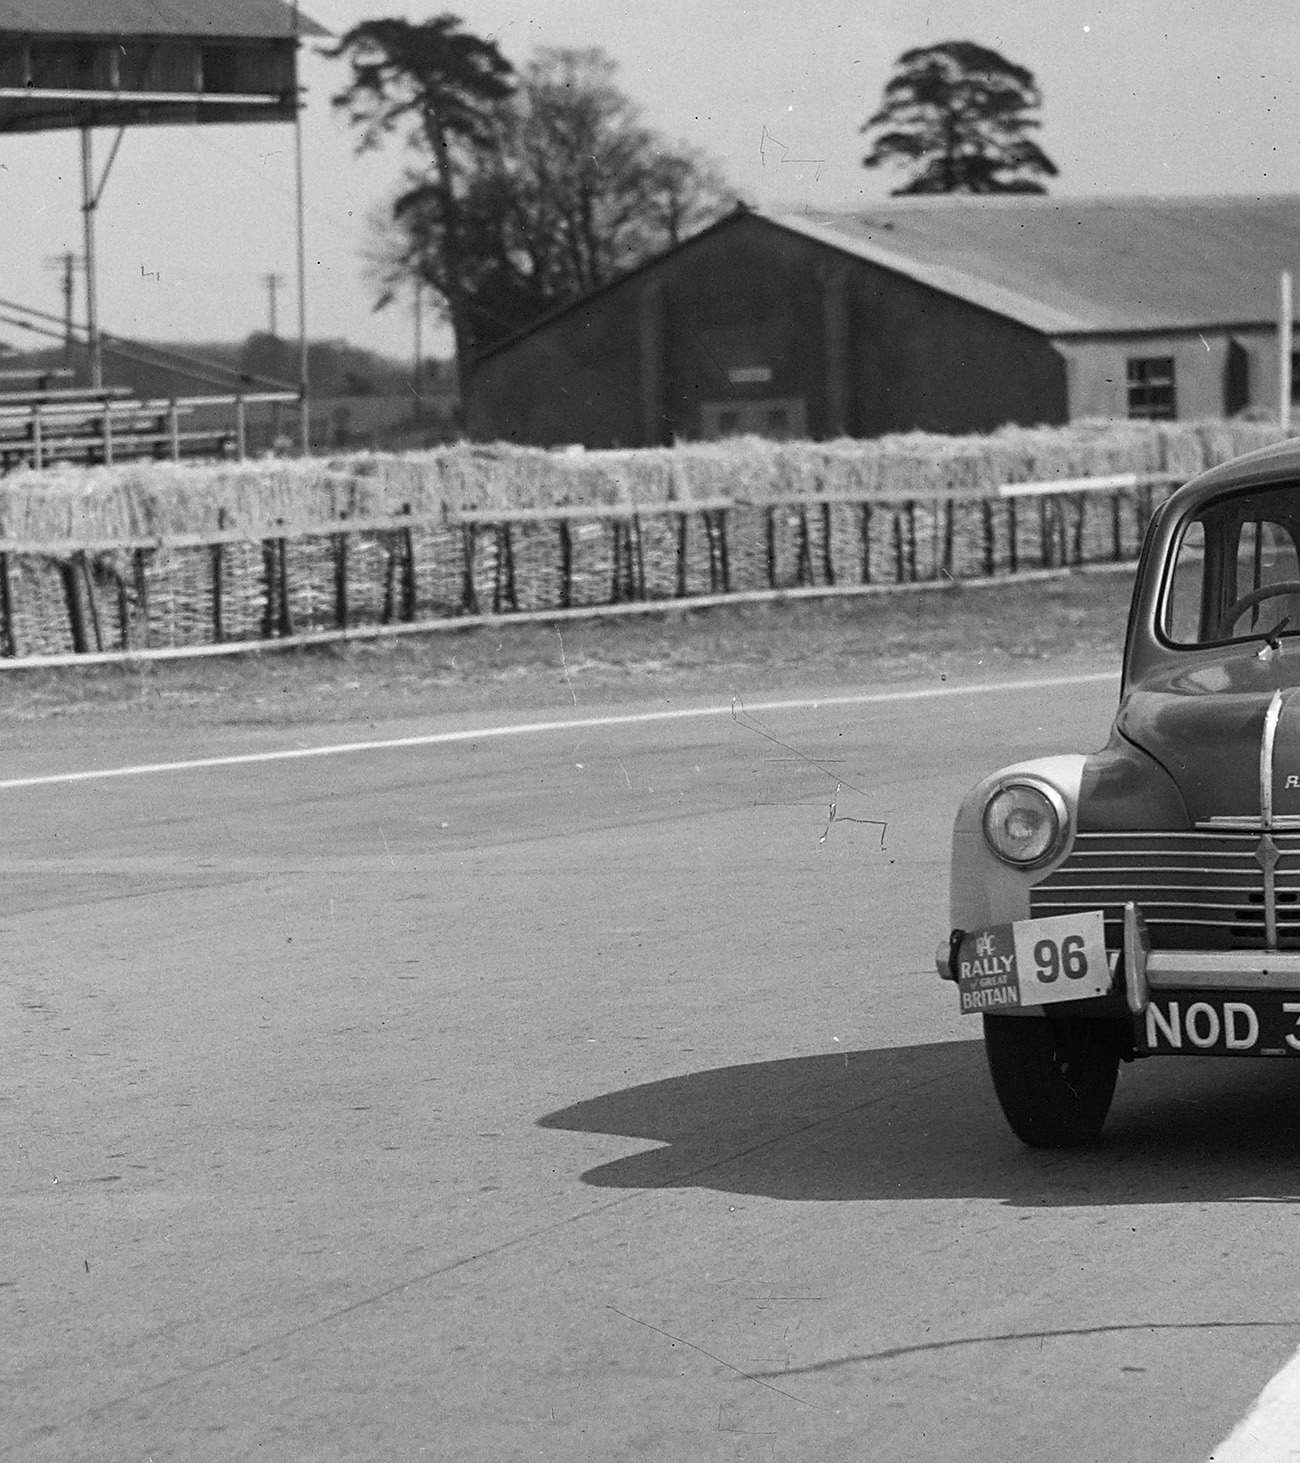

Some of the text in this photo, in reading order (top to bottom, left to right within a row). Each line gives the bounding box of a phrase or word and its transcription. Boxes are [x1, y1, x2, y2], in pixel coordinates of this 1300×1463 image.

[961, 955, 1014, 979] RALLY
[1034, 935, 1088, 984] 96
[979, 975, 1008, 988] GREAT
[962, 985, 1018, 1009] BRITAIN
[1146, 1001, 1259, 1050] NOD
